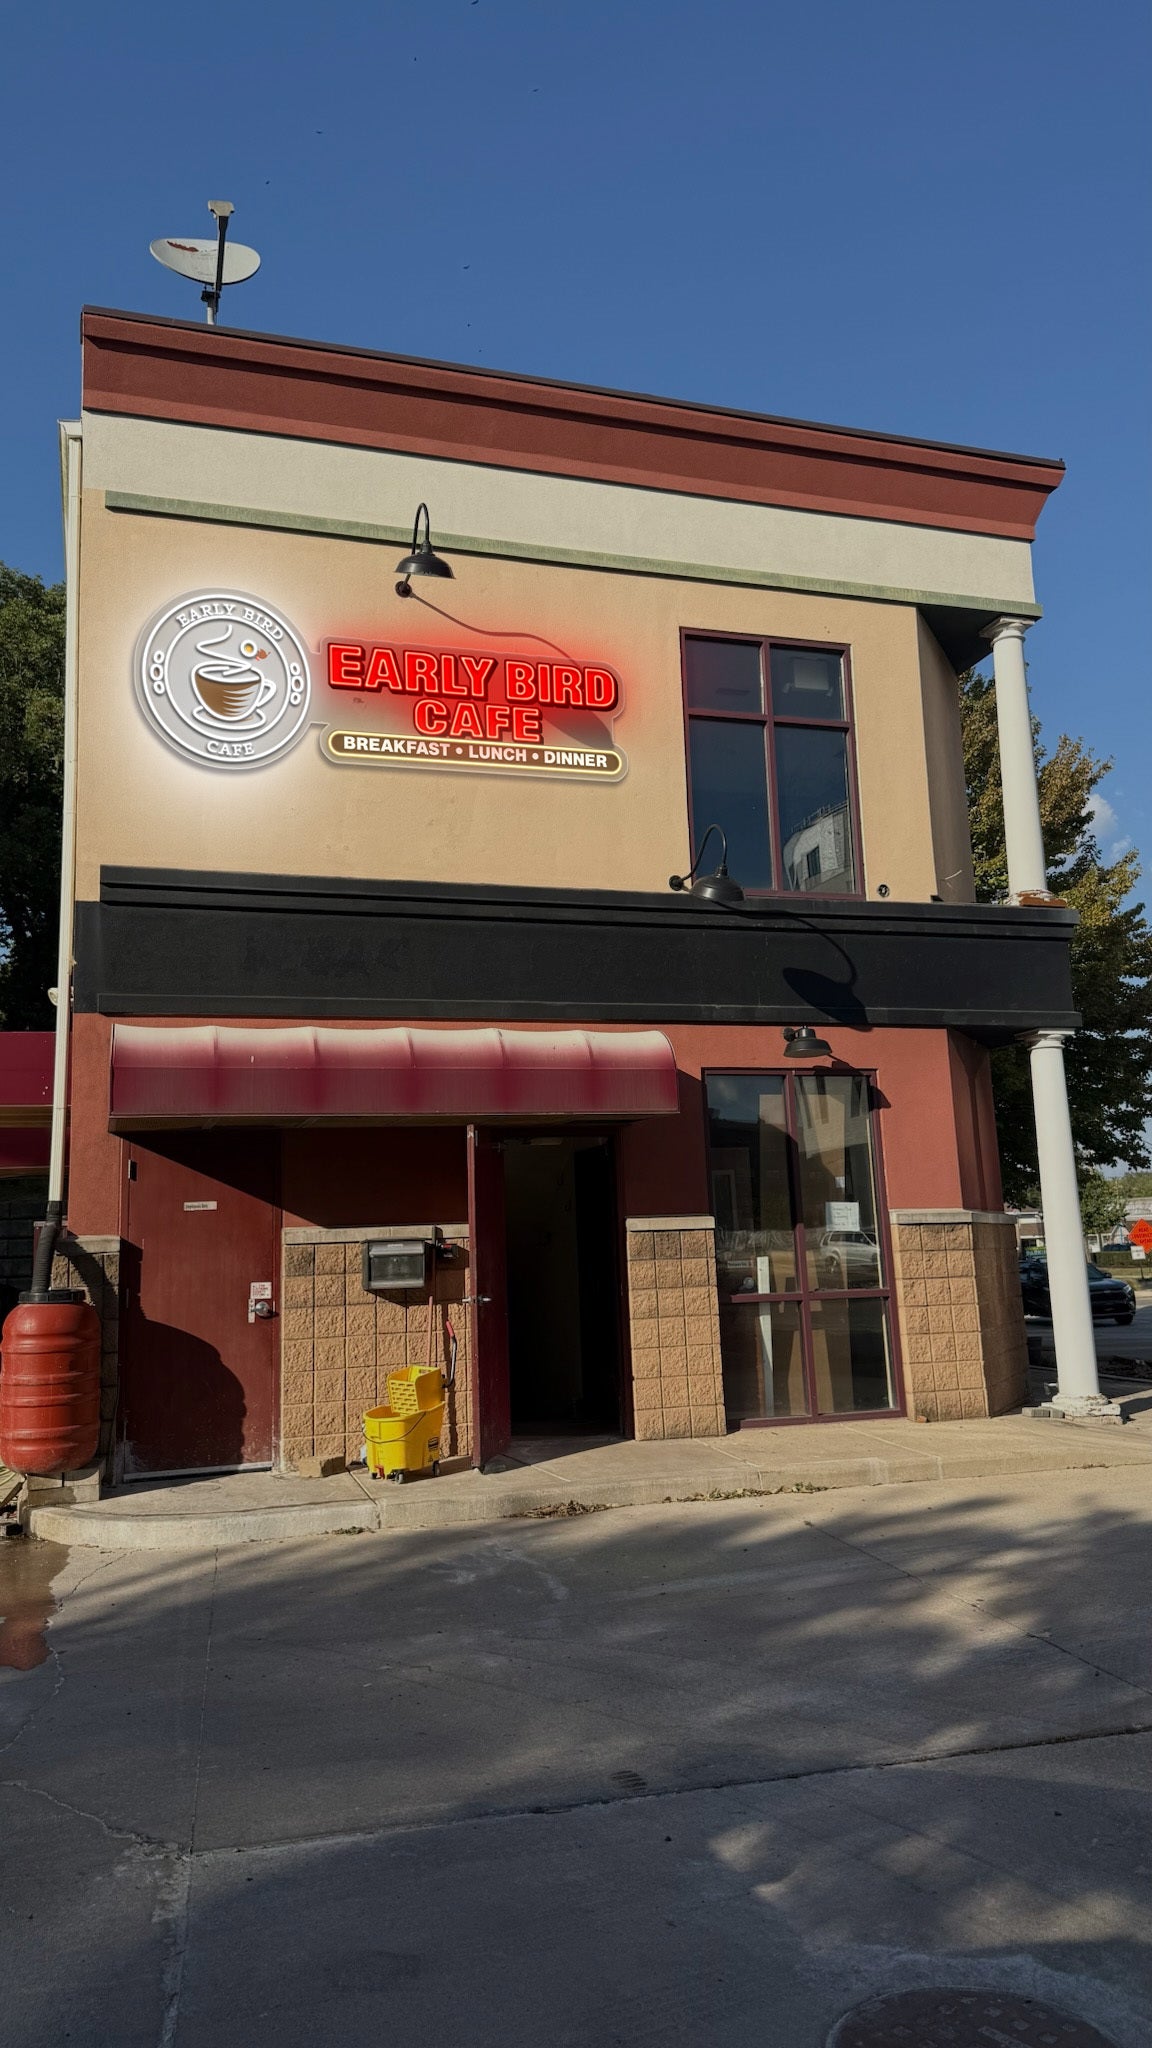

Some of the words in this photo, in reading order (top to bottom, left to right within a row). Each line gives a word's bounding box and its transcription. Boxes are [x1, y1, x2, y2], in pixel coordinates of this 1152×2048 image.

[176, 603, 236, 627] EARLY
[242, 607, 283, 640] BIRD
[328, 643, 497, 699] EARLY
[505, 660, 617, 710] BIRD
[414, 699, 542, 743] CAFE
[206, 740, 255, 757] CAFE
[343, 736, 450, 757] BREAKFAST
[468, 745, 527, 762] LUNCH
[544, 751, 608, 768] DINNER
